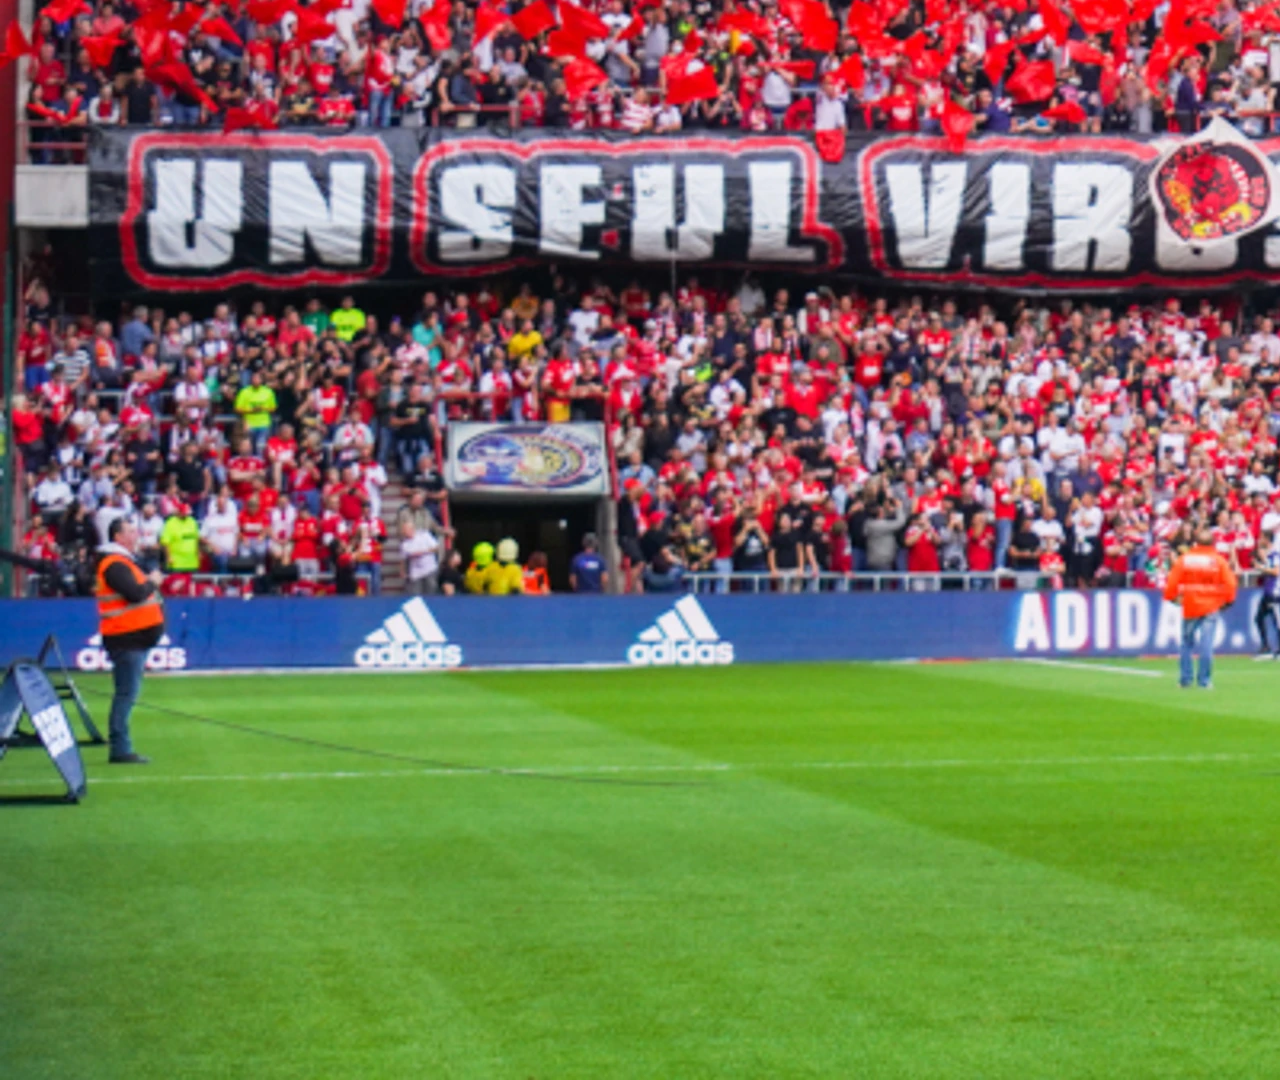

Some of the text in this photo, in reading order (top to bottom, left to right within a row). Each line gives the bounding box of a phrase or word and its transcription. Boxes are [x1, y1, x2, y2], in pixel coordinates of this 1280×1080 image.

[147, 159, 365, 268] UN
[437, 161, 817, 263] SEUL
[354, 643, 462, 667] adidas
[628, 641, 734, 665] adidas
